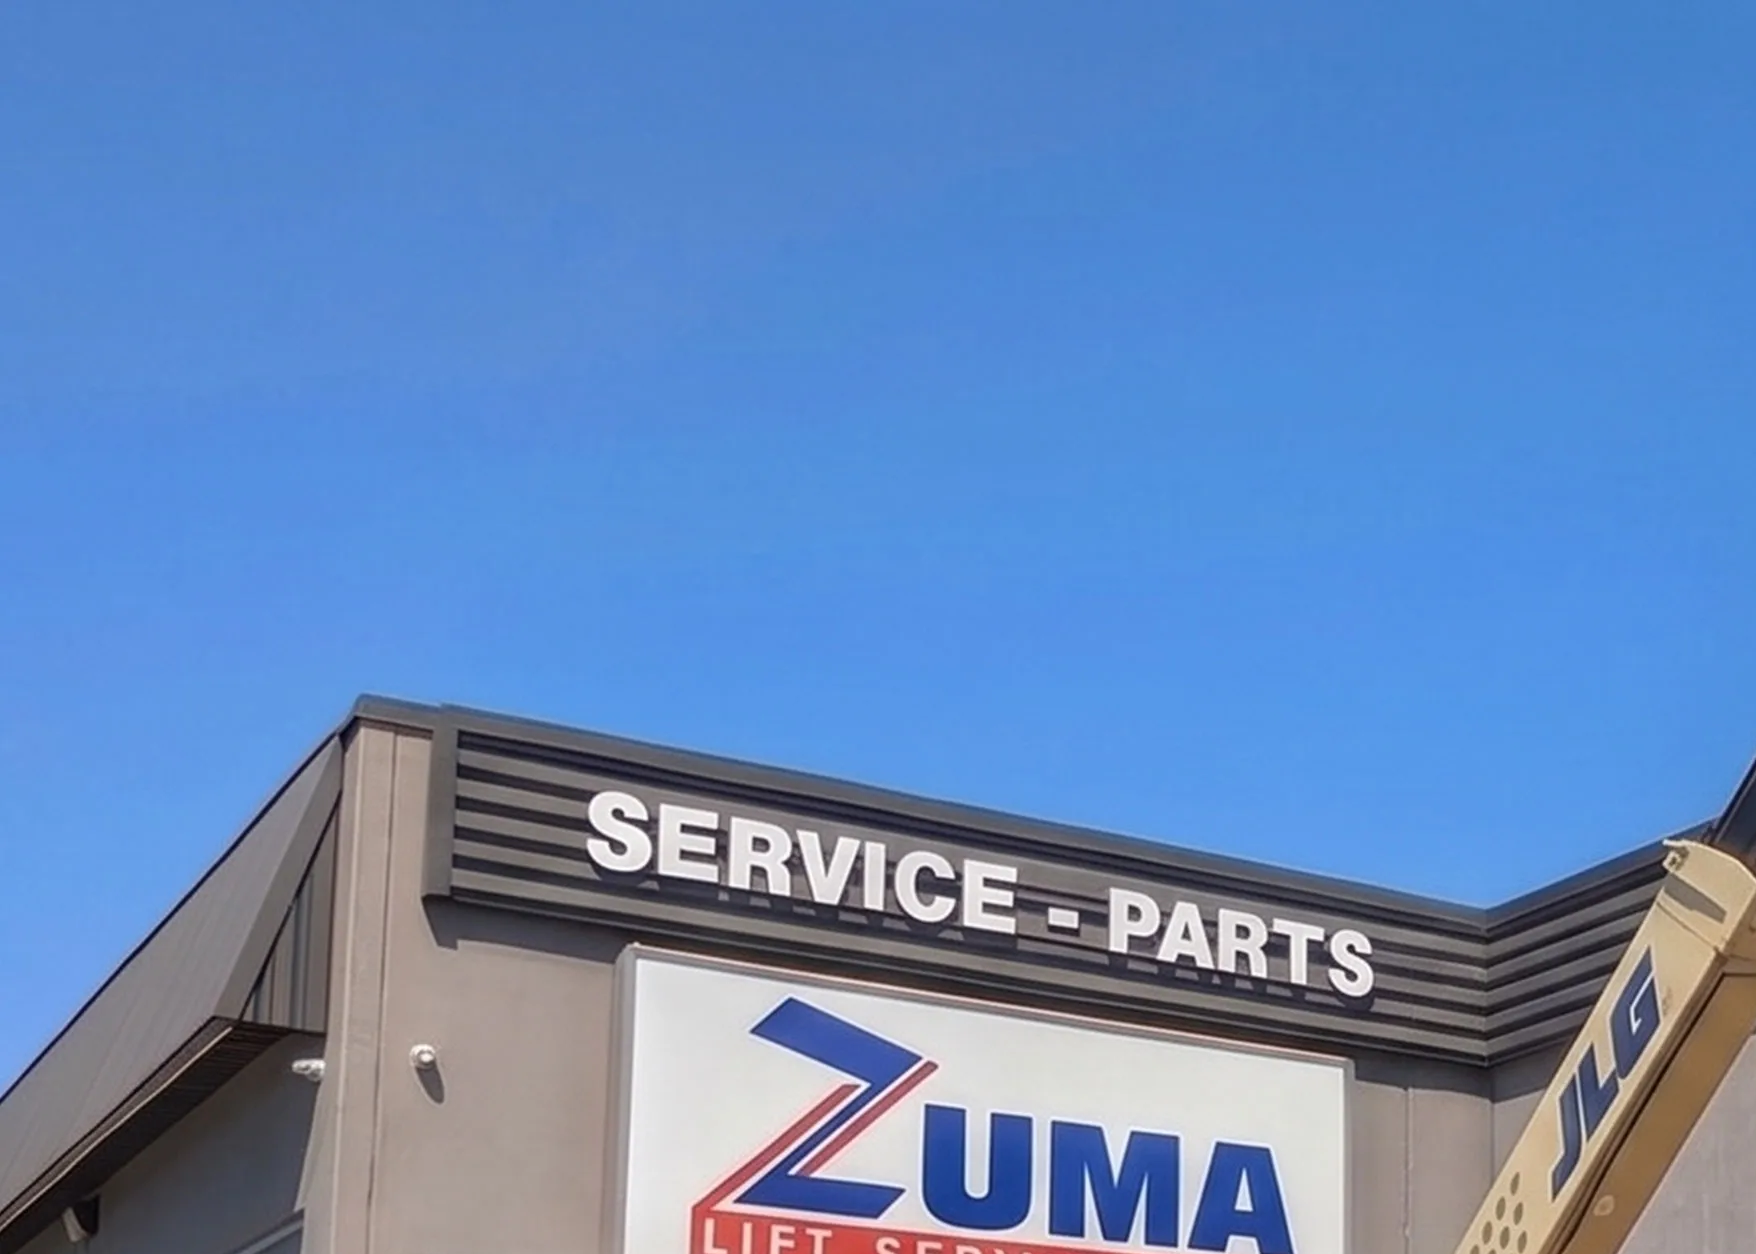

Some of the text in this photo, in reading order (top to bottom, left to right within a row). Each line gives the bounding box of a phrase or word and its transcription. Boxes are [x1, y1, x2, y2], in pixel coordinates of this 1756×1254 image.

[585, 790, 1018, 935] SERVICE
[1107, 886, 1375, 998] PARTS
[1550, 944, 1661, 1204] JLG
